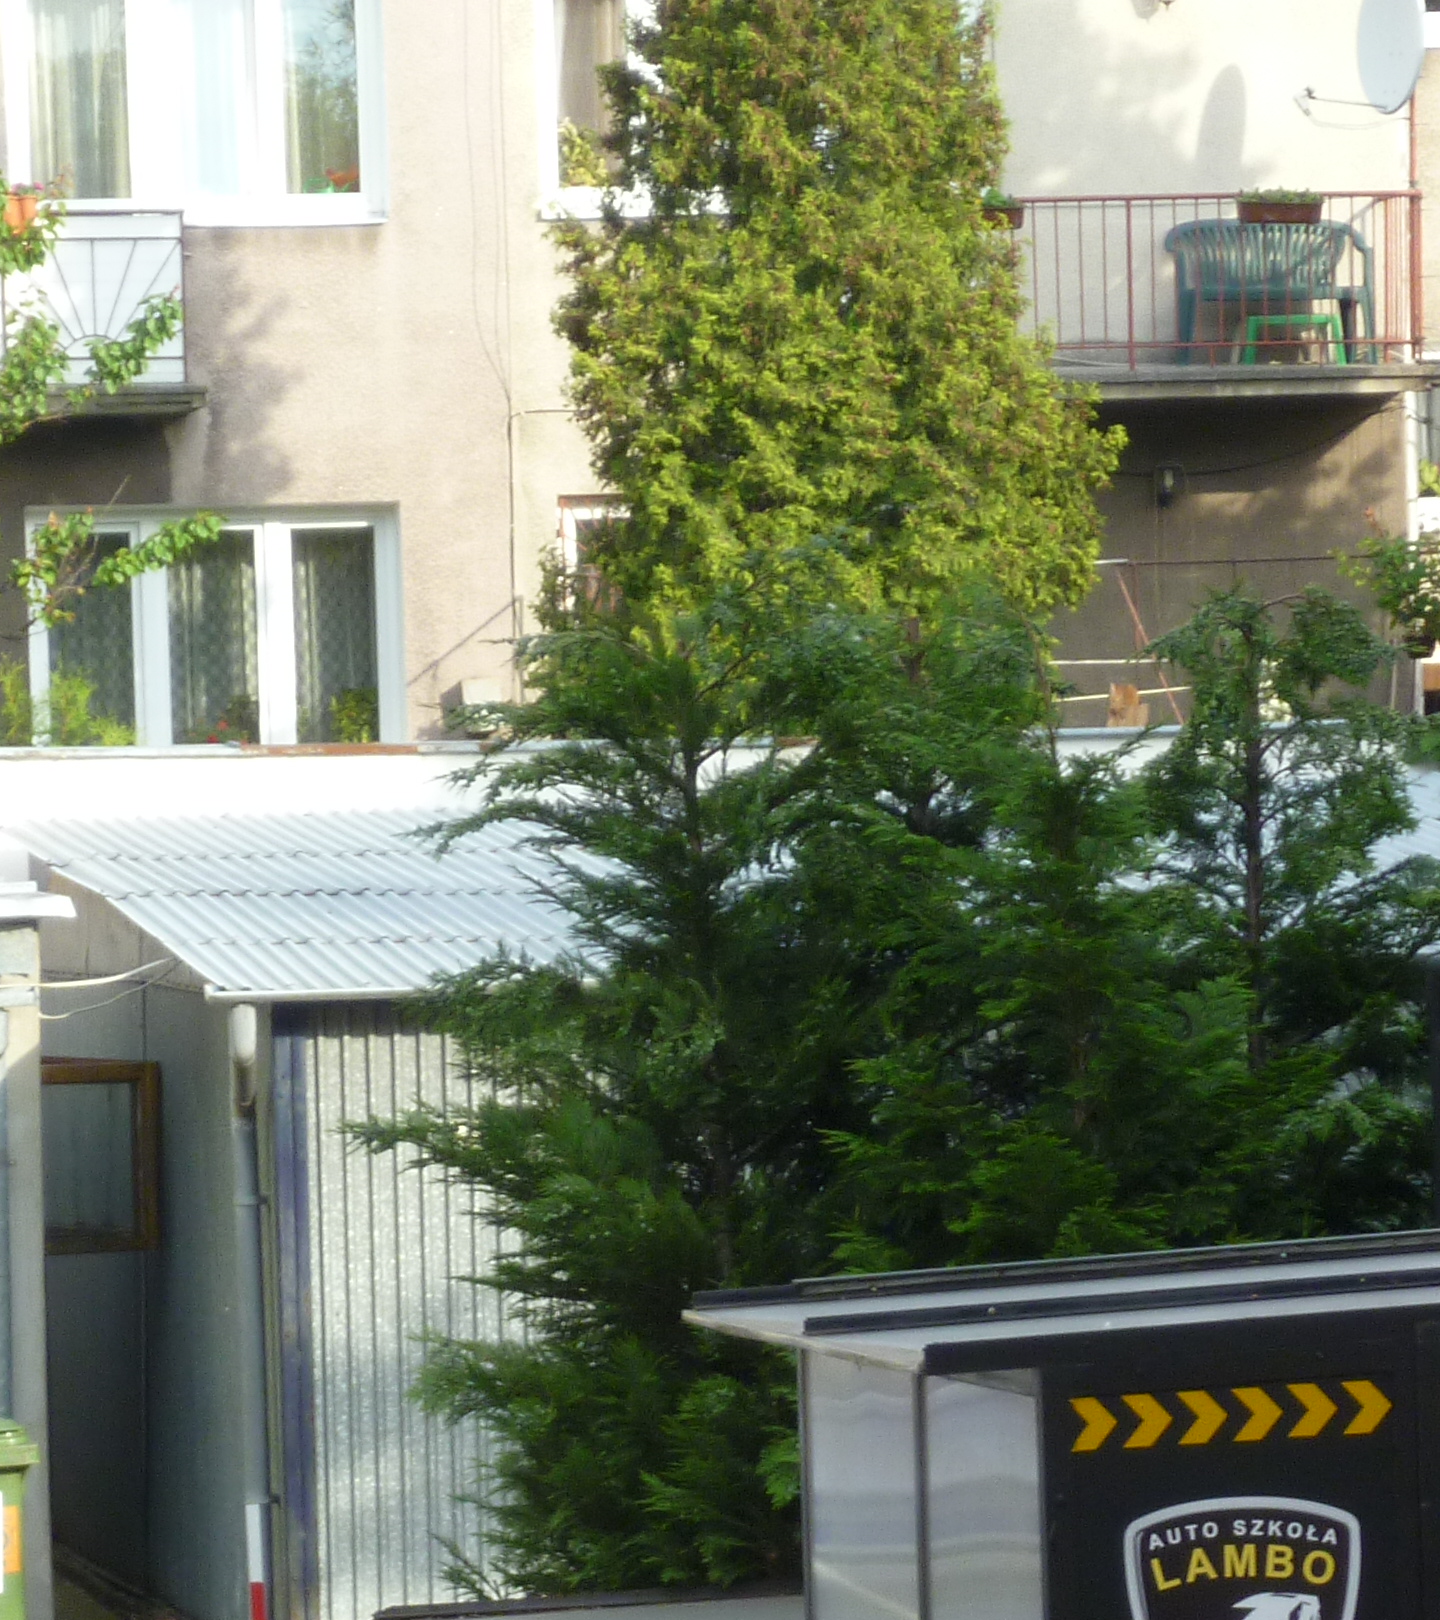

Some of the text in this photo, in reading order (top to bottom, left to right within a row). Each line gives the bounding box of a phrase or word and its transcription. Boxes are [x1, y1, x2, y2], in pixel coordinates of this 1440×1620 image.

[1149, 1519, 1338, 1550] AUTO SZKOŁA
[1150, 1543, 1337, 1591] LAMBO
